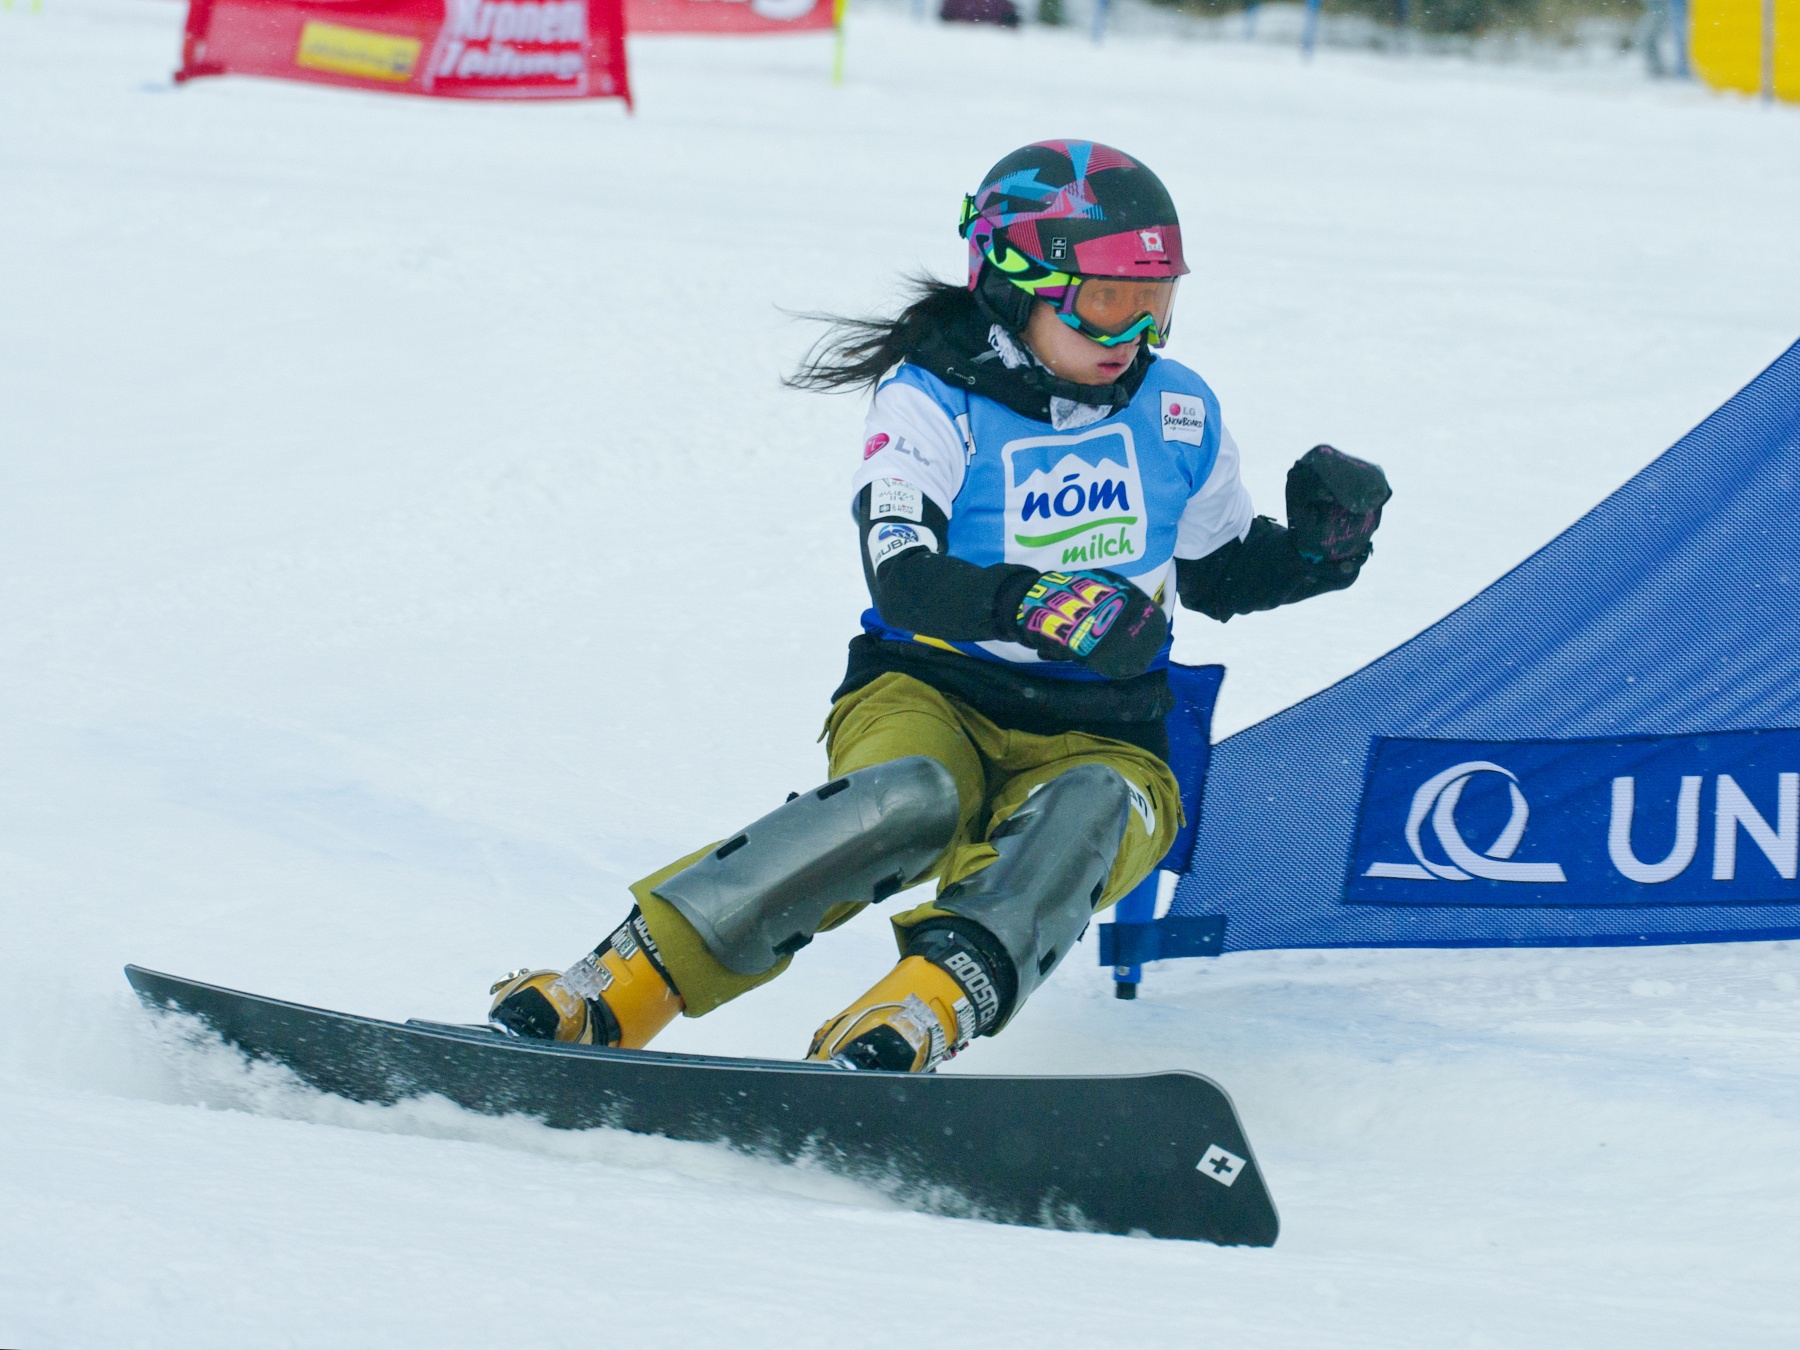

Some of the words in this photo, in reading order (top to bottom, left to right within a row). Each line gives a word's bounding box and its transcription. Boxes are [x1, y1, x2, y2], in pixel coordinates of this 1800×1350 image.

[447, 0, 584, 42] Kronen
[1183, 406, 1196, 416] LG
[1061, 526, 1136, 565] milch
[1608, 771, 1800, 884] UN
